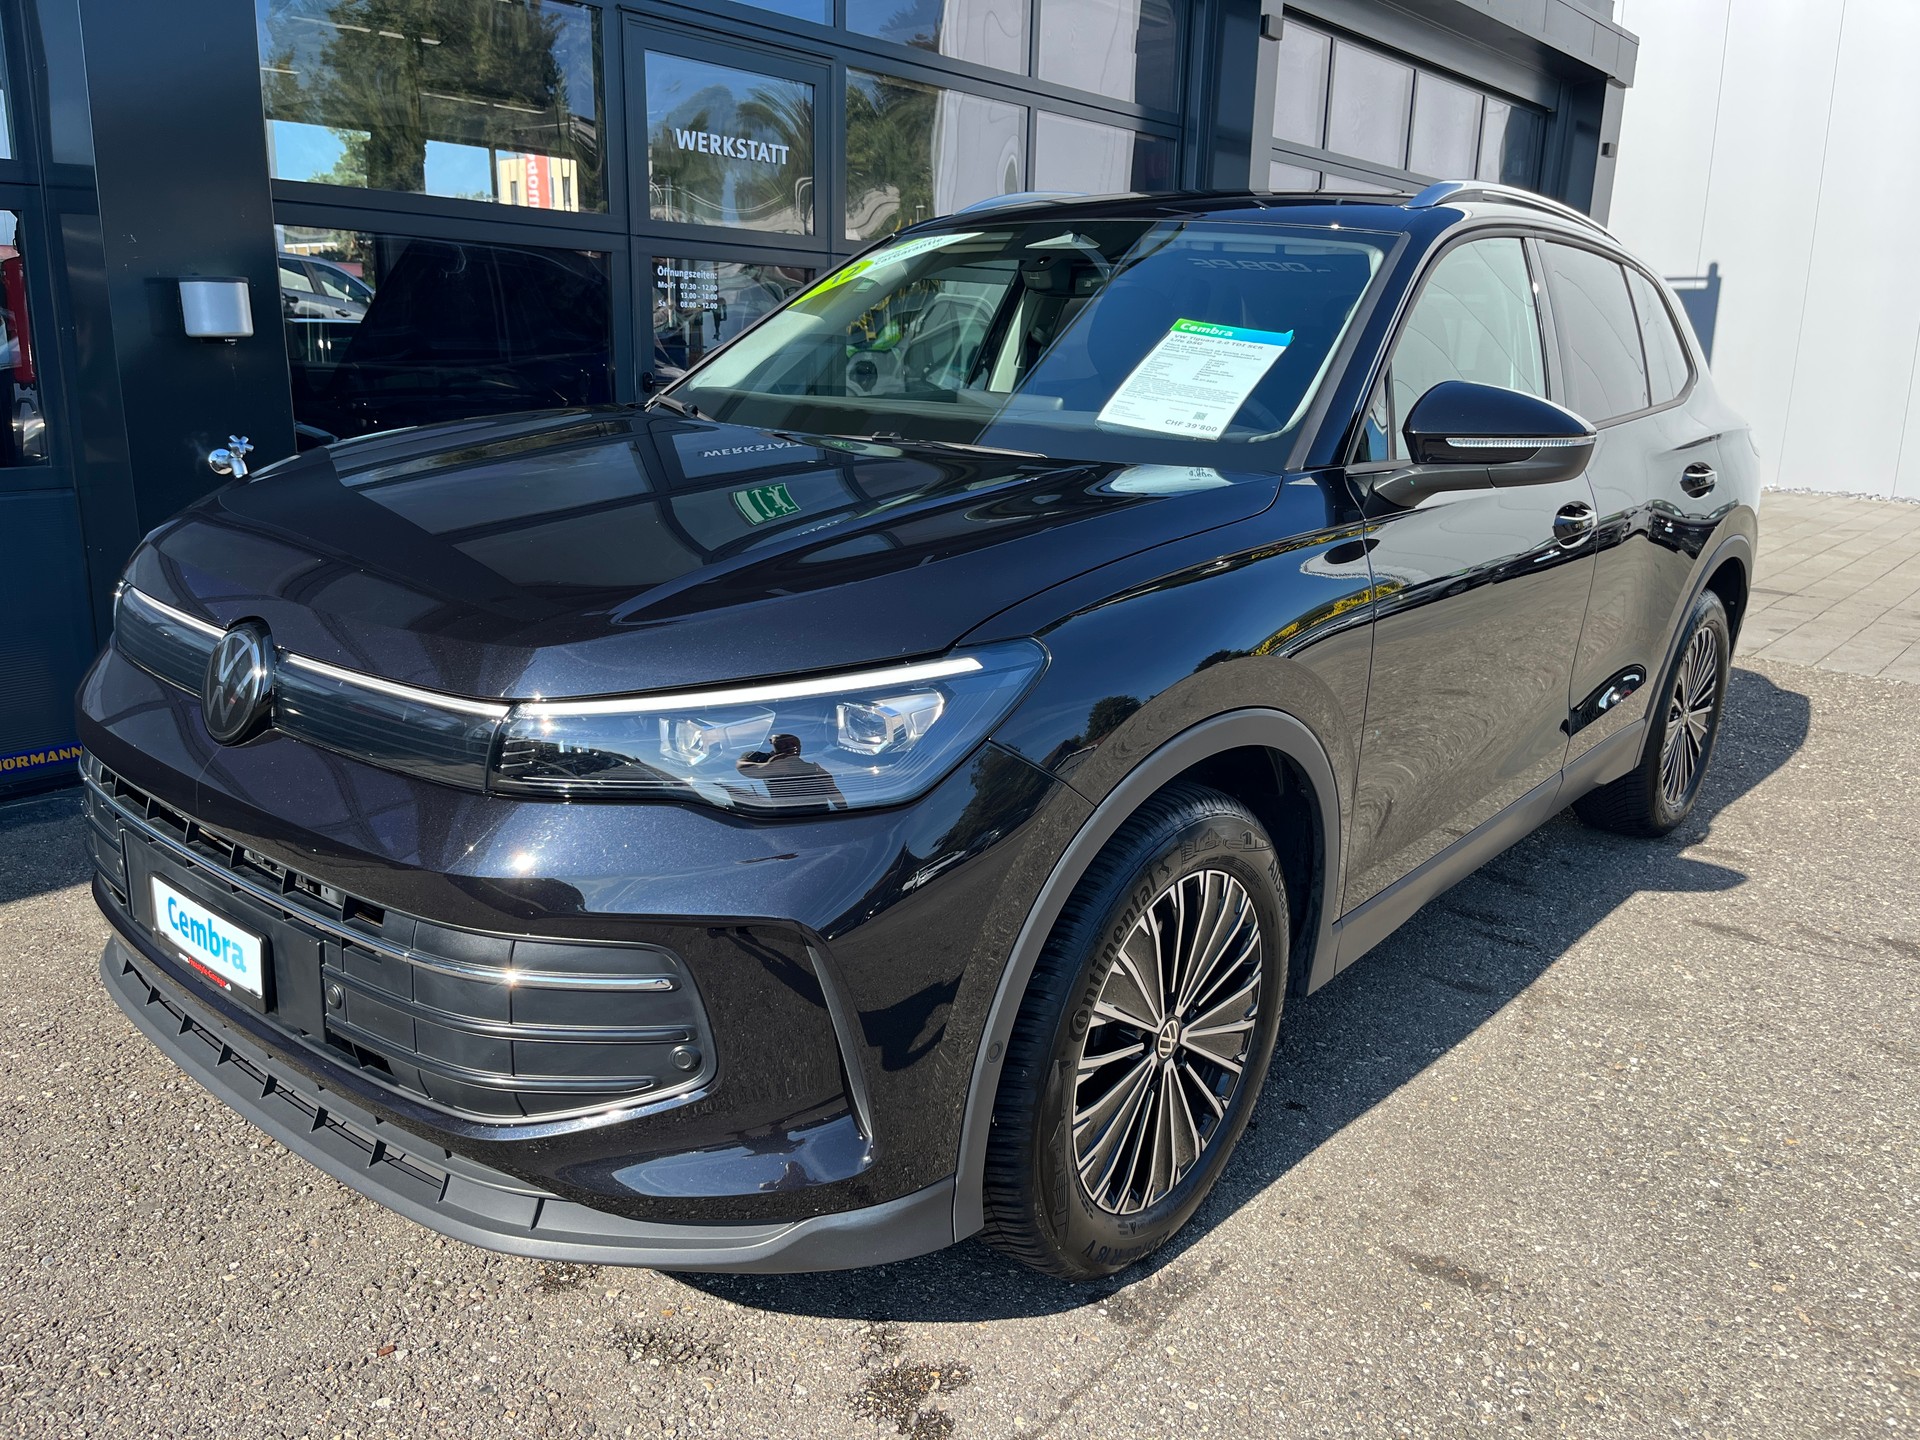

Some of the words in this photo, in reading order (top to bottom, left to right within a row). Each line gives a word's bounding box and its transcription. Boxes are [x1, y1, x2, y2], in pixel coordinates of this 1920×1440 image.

[676, 128, 790, 165] WERKSTATT
[657, 265, 718, 280] Öffnungszeiten:
[702, 293, 718, 301] 18.00
[702, 302, 718, 310] 12.00
[1180, 323, 1234, 337] Cembra
[1189, 336, 1216, 344] Tiguan
[1165, 419, 1185, 427] CHF
[1185, 421, 1218, 432] 39'800
[0, 745, 83, 772] ÖRMANN
[167, 896, 247, 973] Cembra
[1068, 872, 1158, 1042] Continental
